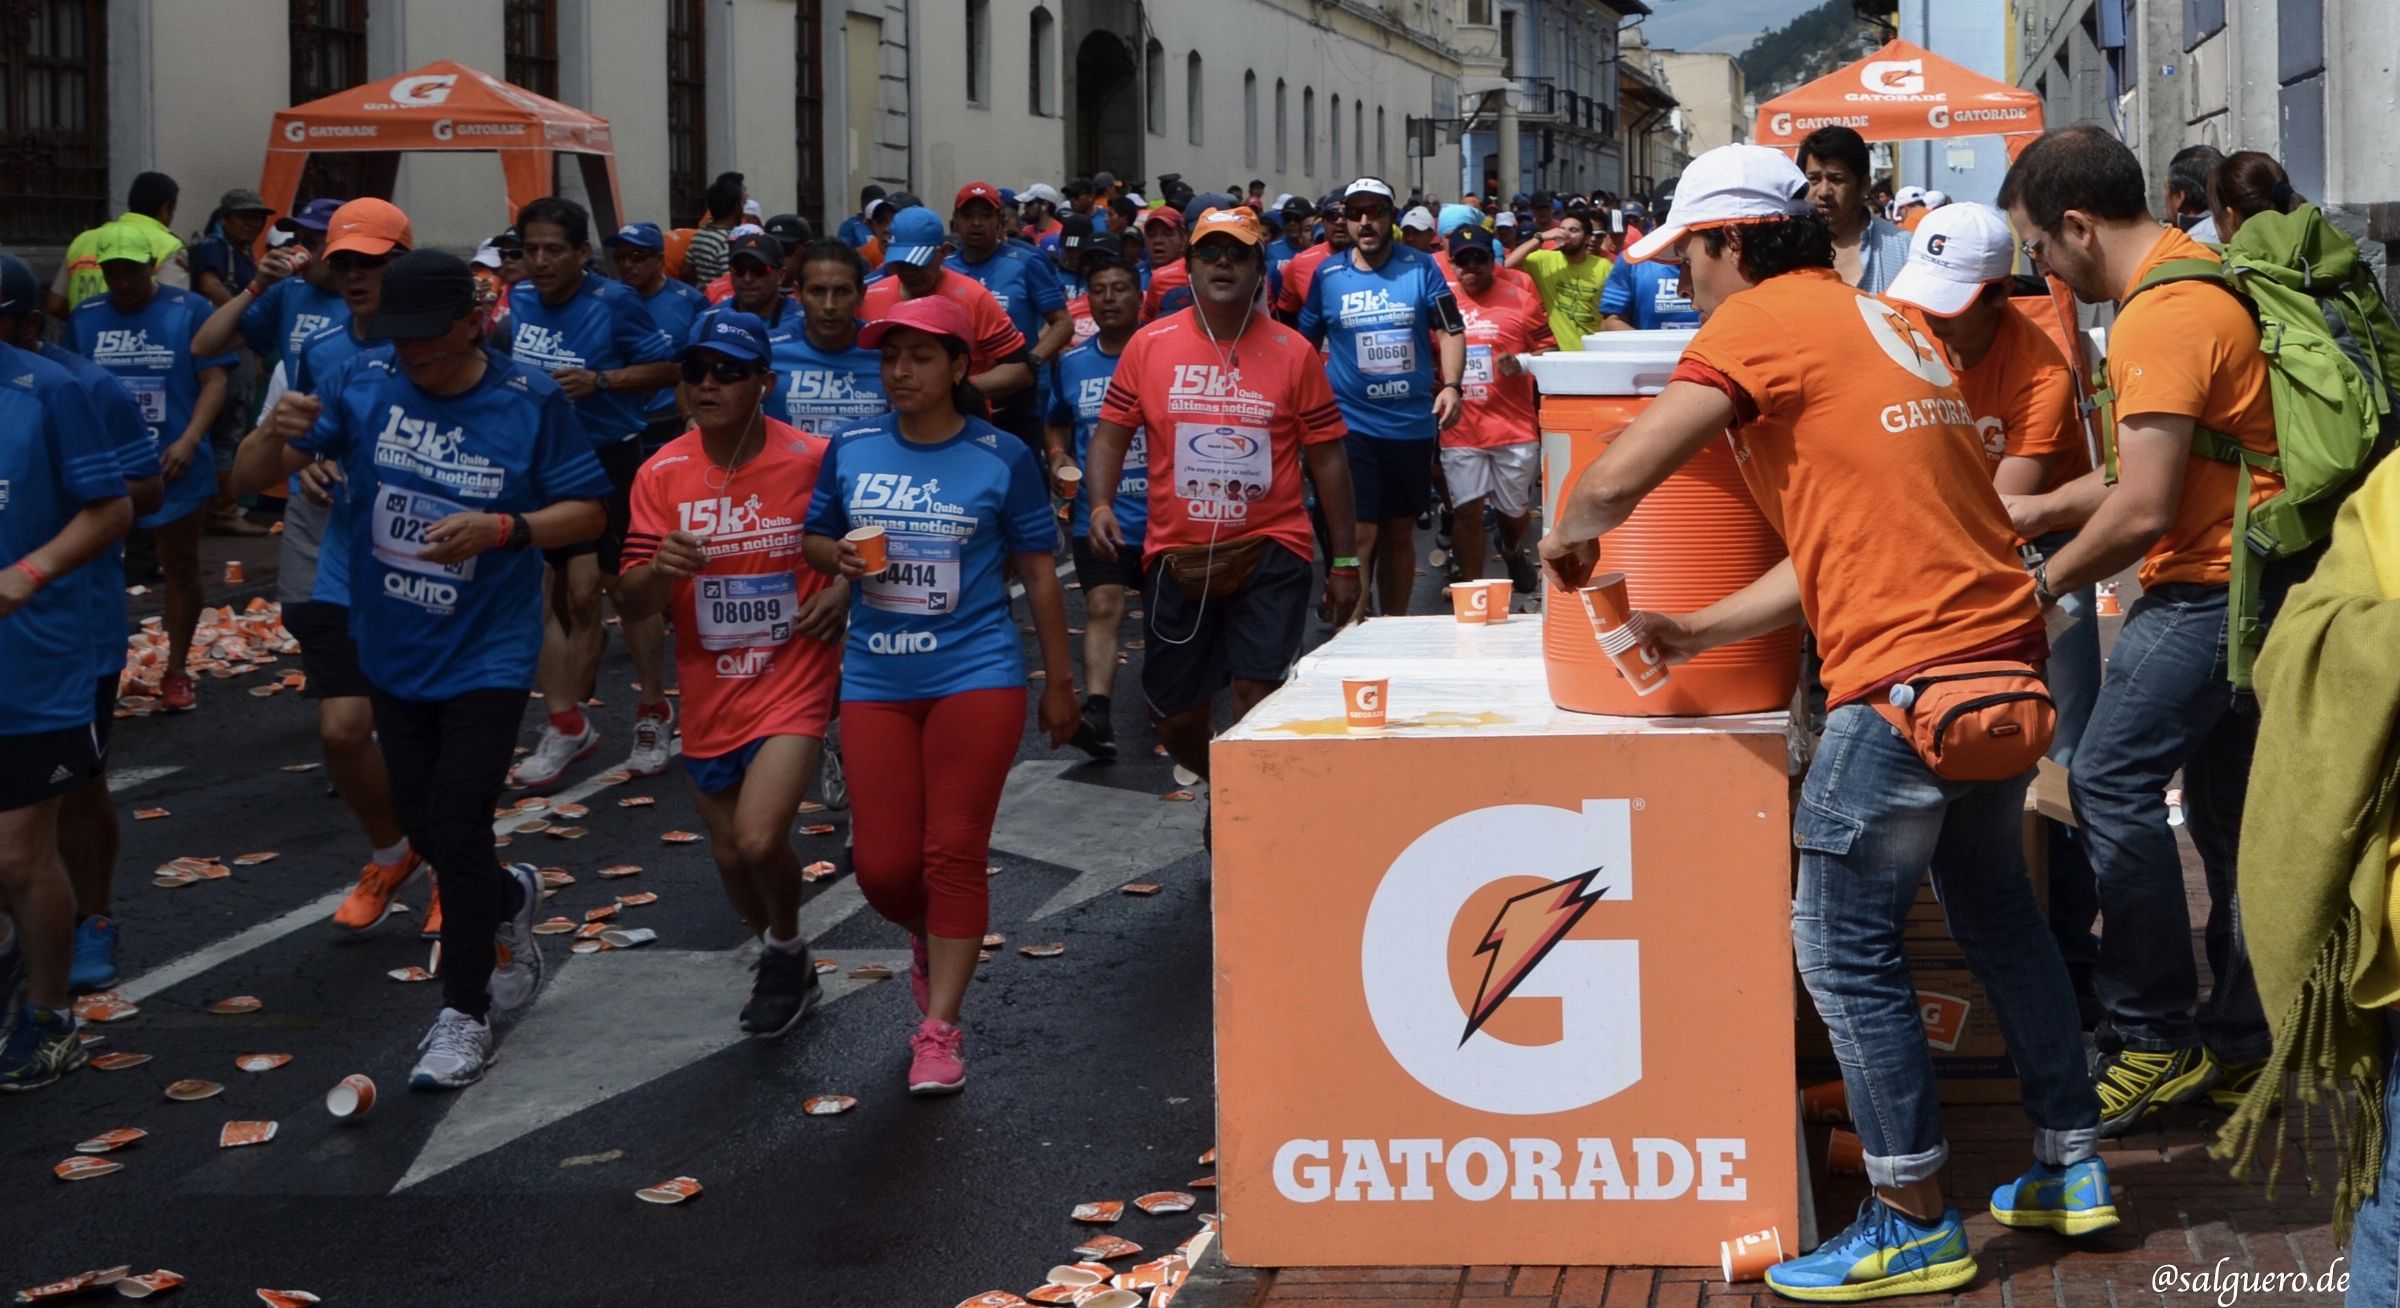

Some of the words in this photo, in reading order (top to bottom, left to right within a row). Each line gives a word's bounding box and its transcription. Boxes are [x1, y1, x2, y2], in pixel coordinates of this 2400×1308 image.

[1796, 115, 1869, 129] GATORADE
[1954, 108, 2027, 122] GATORADE
[309, 125, 378, 137] GATORADE
[457, 123, 525, 136] GATORADE
[1340, 289, 1379, 314] 15k
[94, 329, 138, 353] 15k
[514, 323, 552, 353] 15k
[1368, 345, 1408, 361] 00660
[786, 370, 842, 399] 15k
[1169, 364, 1227, 396] 15k
[1239, 390, 1263, 400] Quito
[1366, 380, 1409, 396] QUITO
[788, 403, 836, 414] últimas
[1171, 400, 1220, 413] últimas
[1221, 403, 1273, 417] noticias
[1880, 399, 1974, 433] GATORA
[379, 404, 448, 460] 15k
[459, 453, 490, 467] Quito
[378, 447, 433, 477] últimas
[435, 467, 501, 489] noticias
[849, 473, 921, 511] 15k
[933, 502, 964, 514] Quito
[678, 496, 744, 536] 15k
[761, 516, 792, 529] Quito
[1187, 499, 1248, 519] QUITO
[909, 519, 976, 537] noticias
[742, 533, 803, 553] noticias
[384, 573, 458, 606] QUITO
[713, 598, 781, 624] 08089
[868, 630, 938, 655] QUITO
[1272, 1136, 1747, 1203] GATORADE
